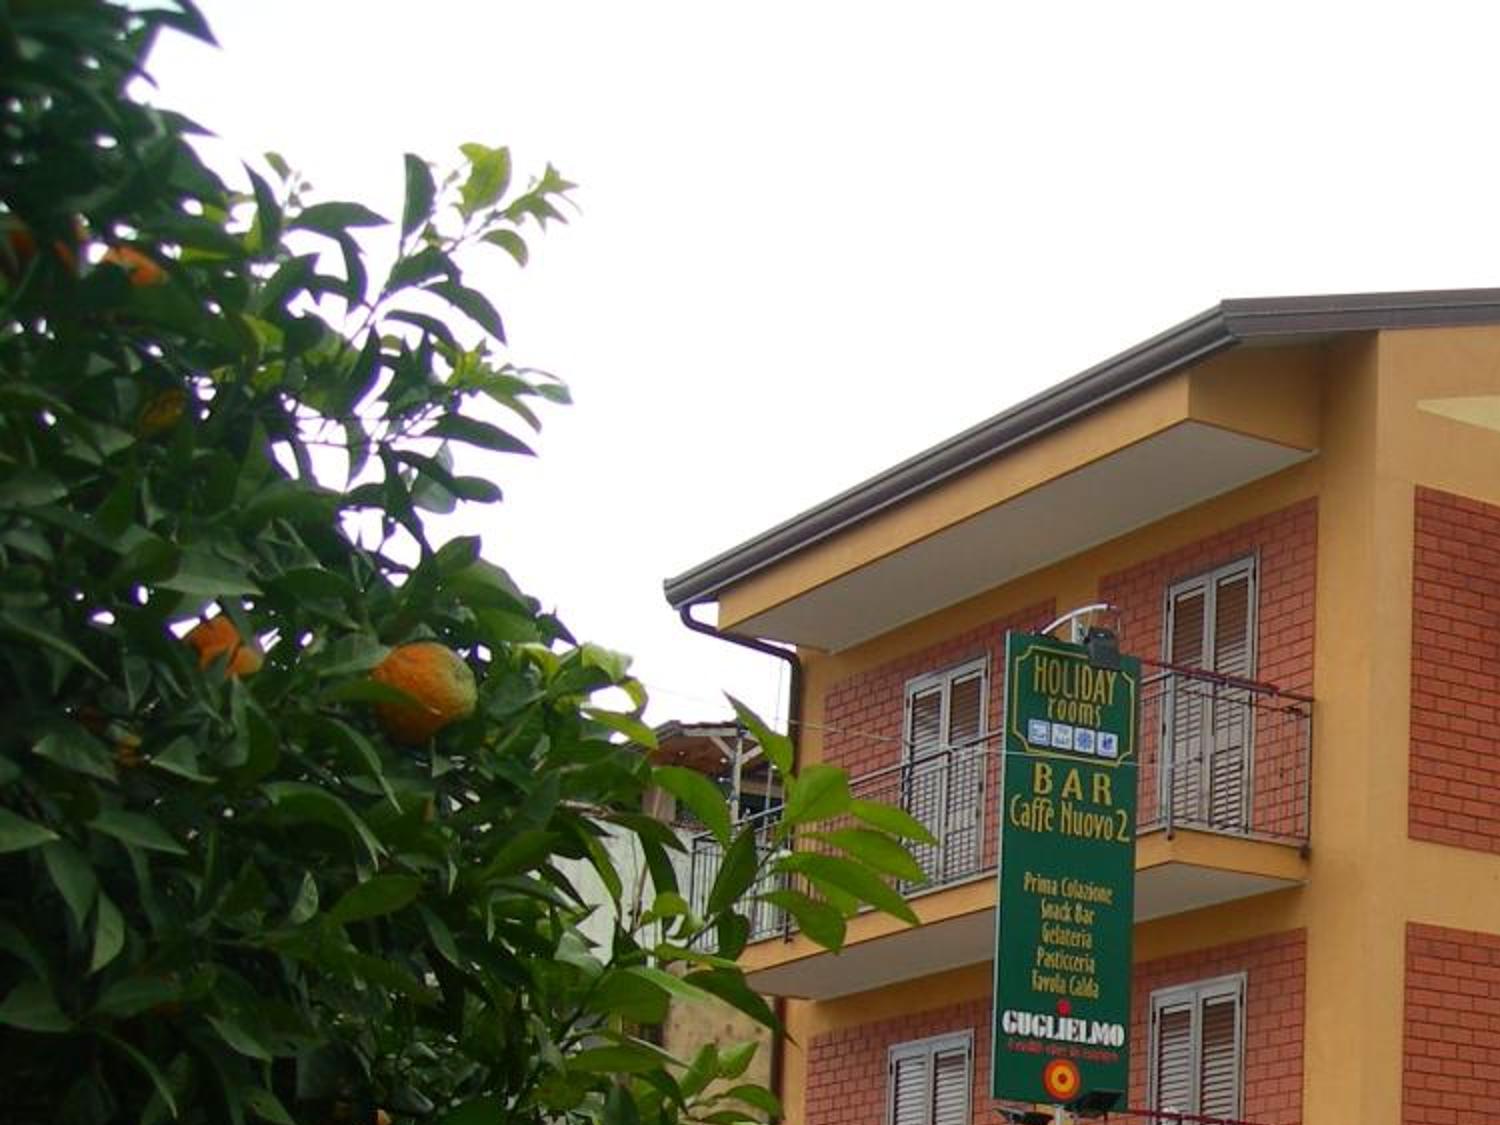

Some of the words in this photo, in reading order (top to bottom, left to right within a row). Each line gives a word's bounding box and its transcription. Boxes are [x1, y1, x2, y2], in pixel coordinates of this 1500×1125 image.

[1033, 656, 1117, 704] HOLIDAY
[1047, 697, 1101, 728] rooms
[1033, 762, 1112, 806] BAR
[1061, 800, 1113, 840] Nuovo
[1115, 809, 1130, 842] 2
[1023, 871, 1058, 896] Prima
[1061, 877, 1113, 904] Colazione
[1041, 898, 1072, 922] Snack
[1075, 903, 1095, 925] Bar
[1041, 922, 1093, 949] Gelateria
[1037, 946, 1095, 974] Pasticceria
[1032, 969, 1066, 994] Tavola
[1069, 975, 1099, 999] Calda
[1002, 1010, 1125, 1047] GUGLIELMO
